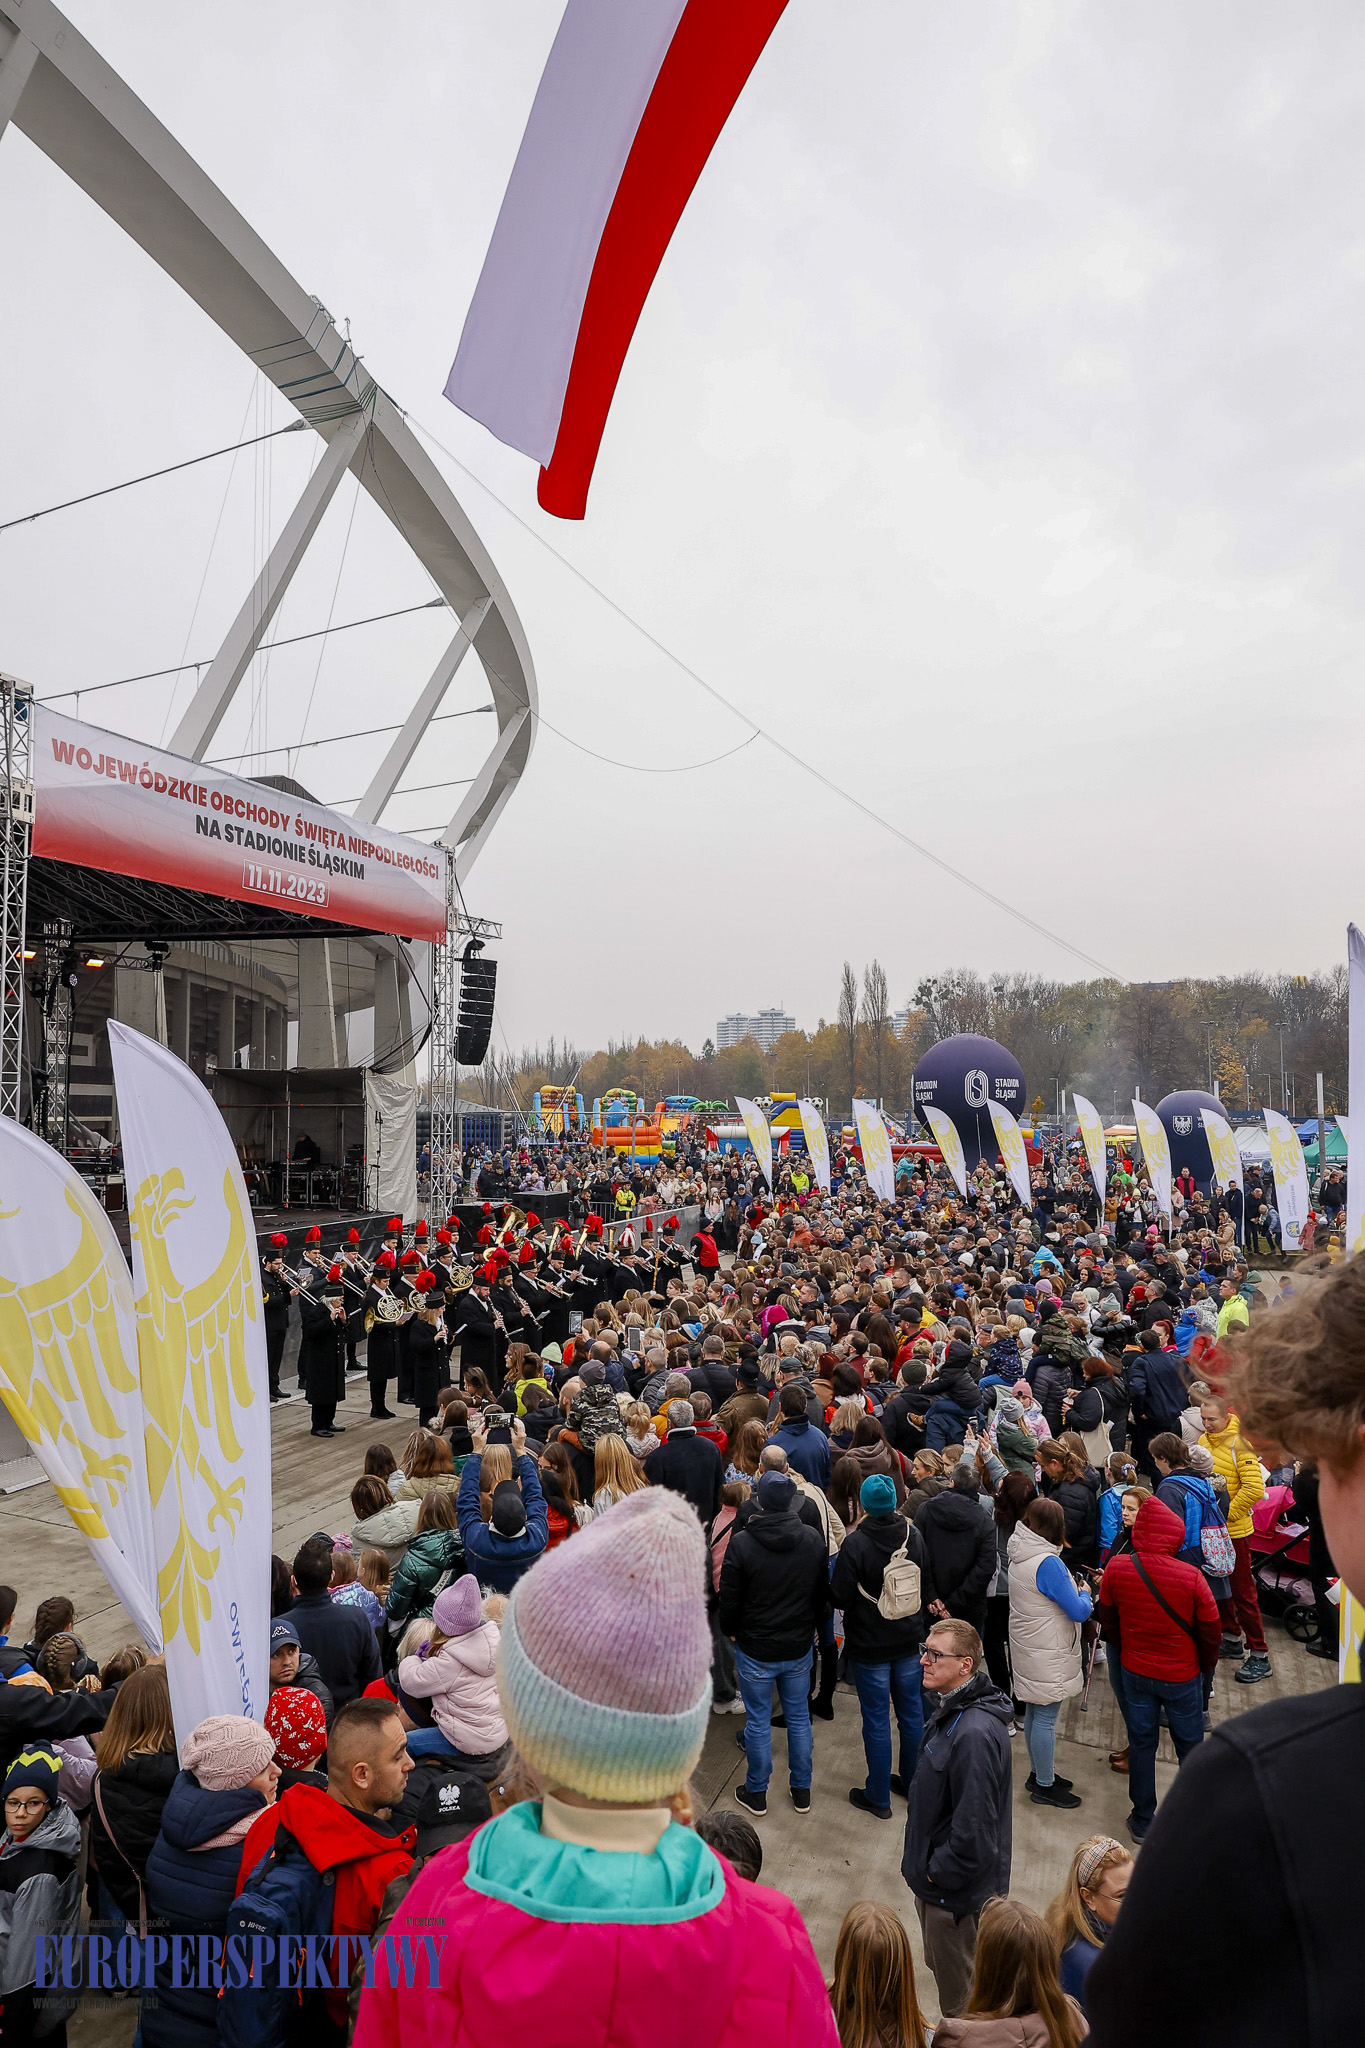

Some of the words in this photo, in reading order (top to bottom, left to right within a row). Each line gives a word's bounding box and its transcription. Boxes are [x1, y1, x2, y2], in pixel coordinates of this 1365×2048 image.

[51, 738, 208, 807] WOJEWÓDZKIE
[210, 791, 290, 832] OBCHODY
[294, 813, 346, 850] ŚWIĘTA
[348, 836, 439, 880] NIEPODLEGŁOŚCI
[195, 814, 222, 840] NA
[224, 823, 306, 864] STADIONIE
[308, 843, 365, 880] ŚLĄSKIM
[248, 864, 327, 904] 11.11.2023
[915, 1080, 938, 1091] STADION
[995, 1078, 1020, 1088] STADION
[915, 1090, 934, 1103] ŚLĄSKI
[995, 1088, 1017, 1101] ŚLĄSKI
